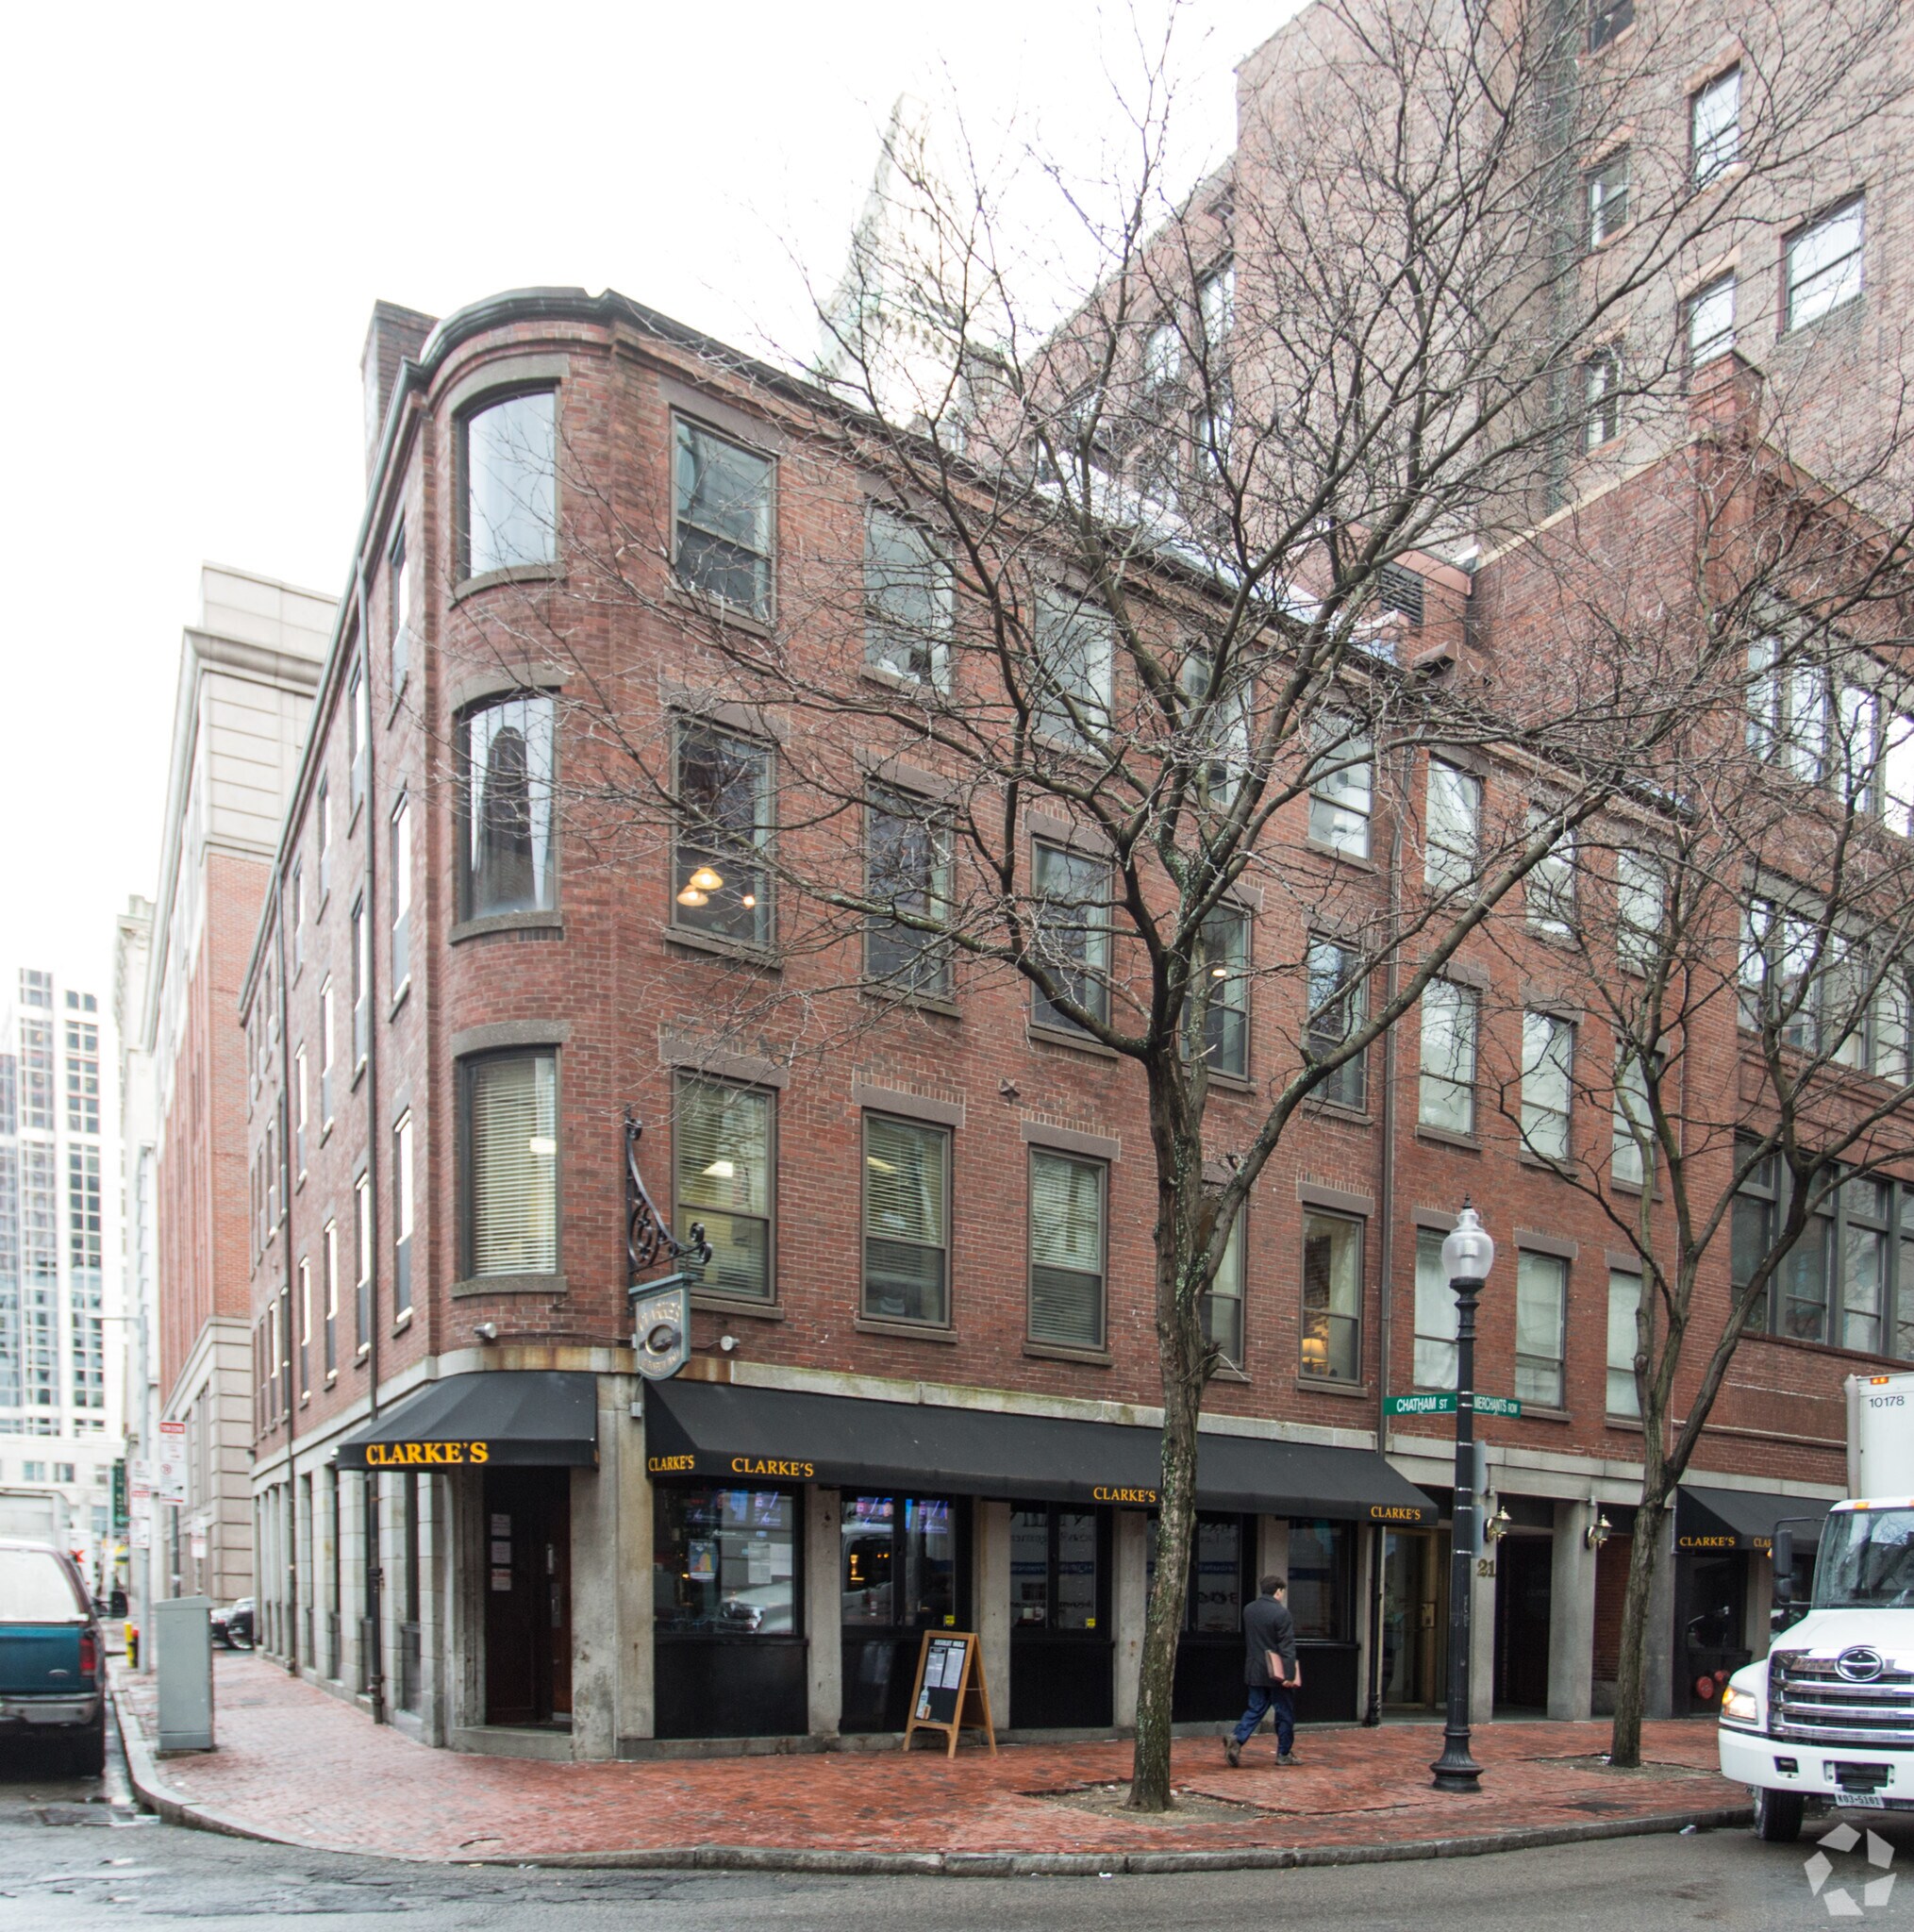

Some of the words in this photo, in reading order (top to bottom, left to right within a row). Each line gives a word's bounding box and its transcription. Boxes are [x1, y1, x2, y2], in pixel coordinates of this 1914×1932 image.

[1396, 1396, 1437, 1413] CHATHAM
[1439, 1398, 1448, 1409] ST
[1473, 1396, 1506, 1413] MERCHANTS
[1507, 1403, 1518, 1414] ROW
[1869, 1395, 1905, 1407] 10178
[366, 1441, 490, 1465] CLARKE'S
[648, 1455, 694, 1472] CLARKE'S
[731, 1457, 814, 1477] CLARKE'S
[1093, 1487, 1157, 1503] CLARKE'S
[1371, 1506, 1421, 1520] CLARKE'S
[1679, 1537, 1736, 1546] CLARKE'S
[1477, 1558, 1495, 1577] 21
